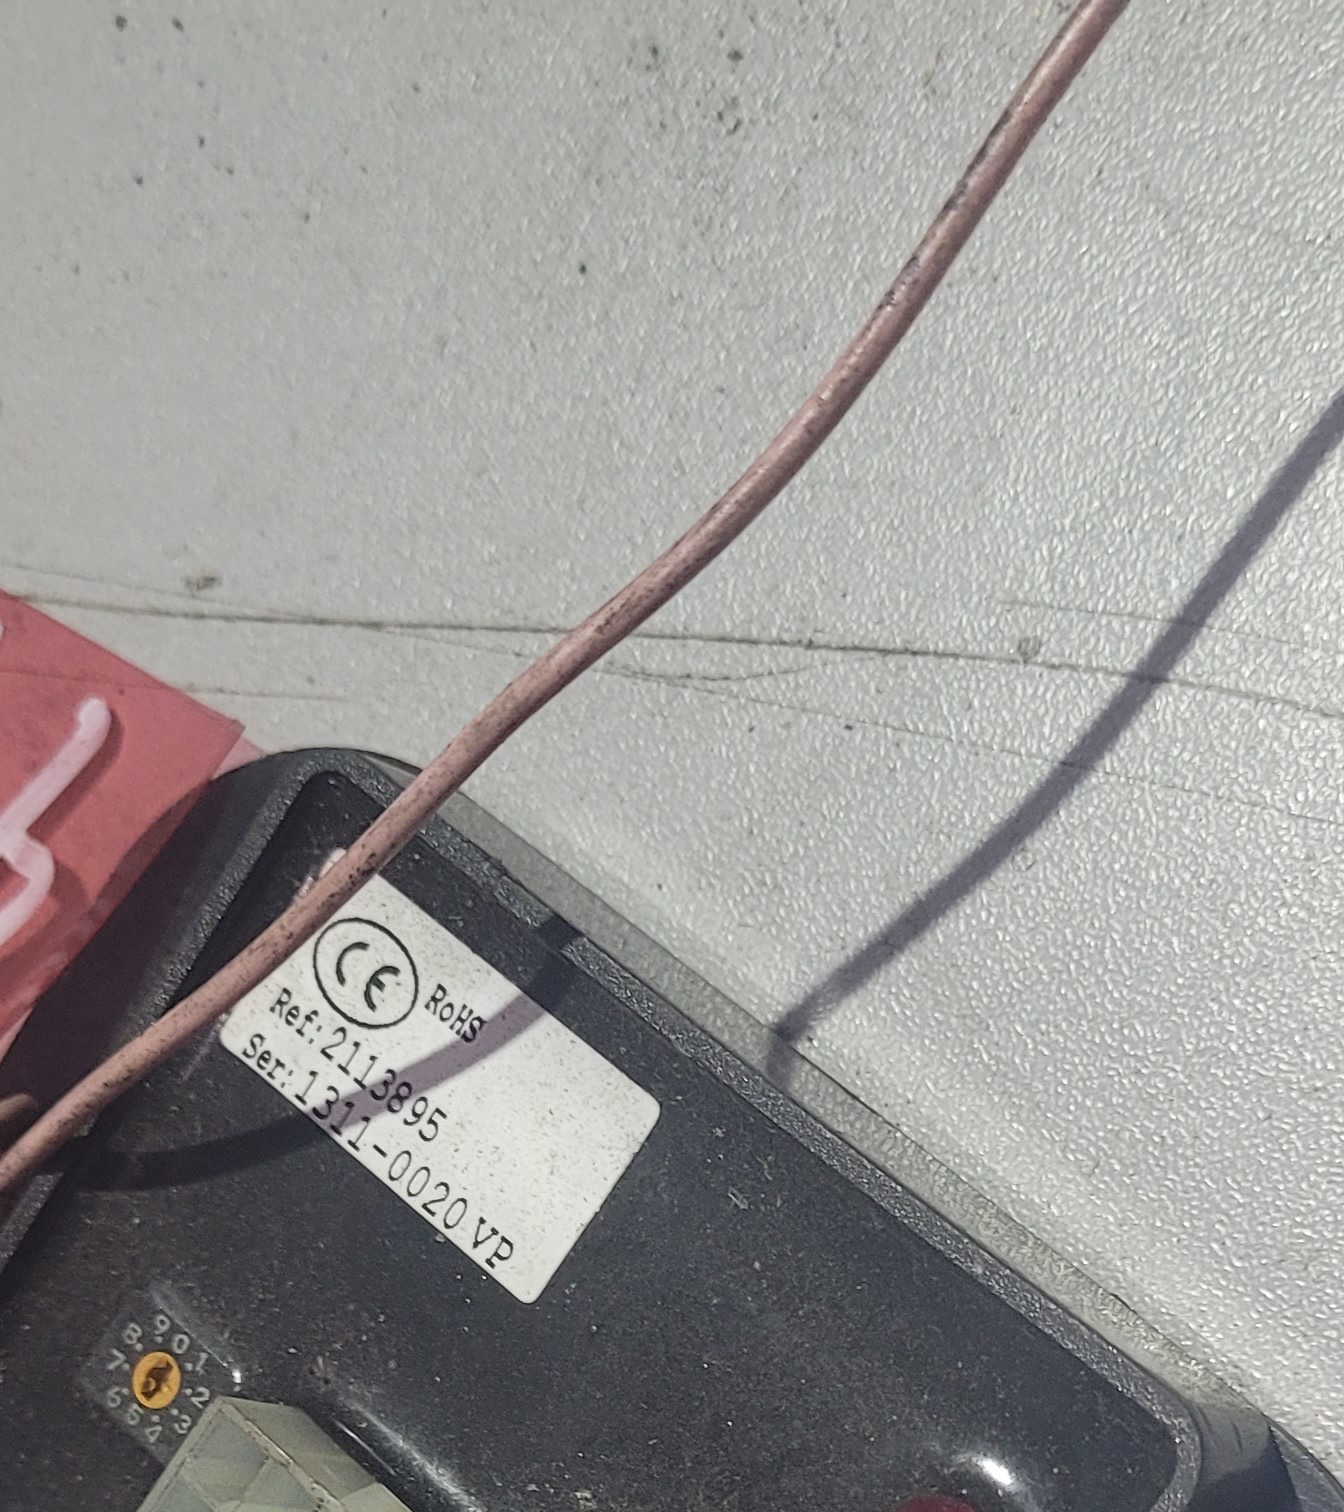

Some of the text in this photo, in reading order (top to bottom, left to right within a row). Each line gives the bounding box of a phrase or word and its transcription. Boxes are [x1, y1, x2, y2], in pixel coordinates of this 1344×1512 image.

[335, 941, 401, 1013] CE
[424, 983, 487, 1044] RoHS
[122, 1321, 143, 1344] 8
[154, 1314, 171, 1335] 9
[171, 1334, 191, 1354] 0
[107, 1349, 127, 1370] 7
[194, 1352, 208, 1375] 1
[107, 1386, 122, 1408] 6
[190, 1386, 210, 1409] 2
[127, 1402, 144, 1426] 5
[174, 1414, 192, 1435] 3
